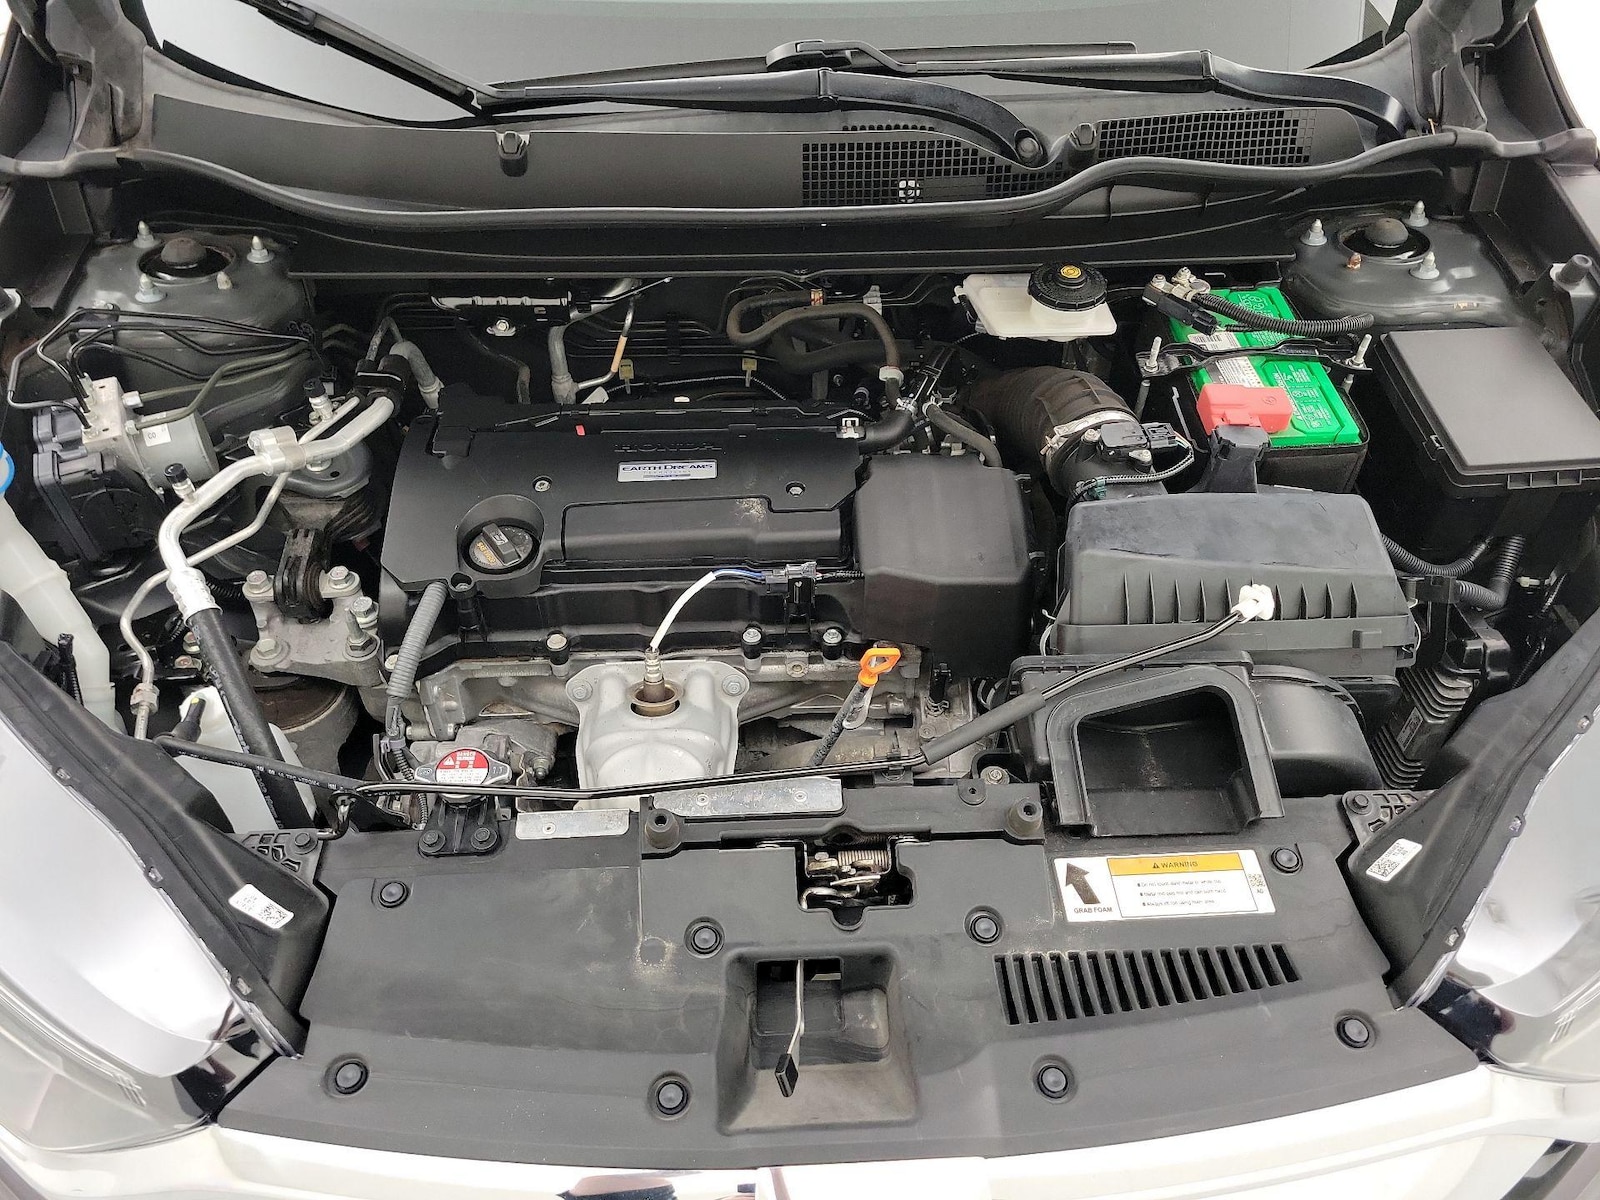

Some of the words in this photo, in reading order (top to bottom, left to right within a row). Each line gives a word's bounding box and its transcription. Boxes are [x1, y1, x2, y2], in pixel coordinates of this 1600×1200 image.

[614, 443, 722, 453] HONDA
[664, 463, 713, 471] DREAMS
[1161, 860, 1199, 869] WARNING
